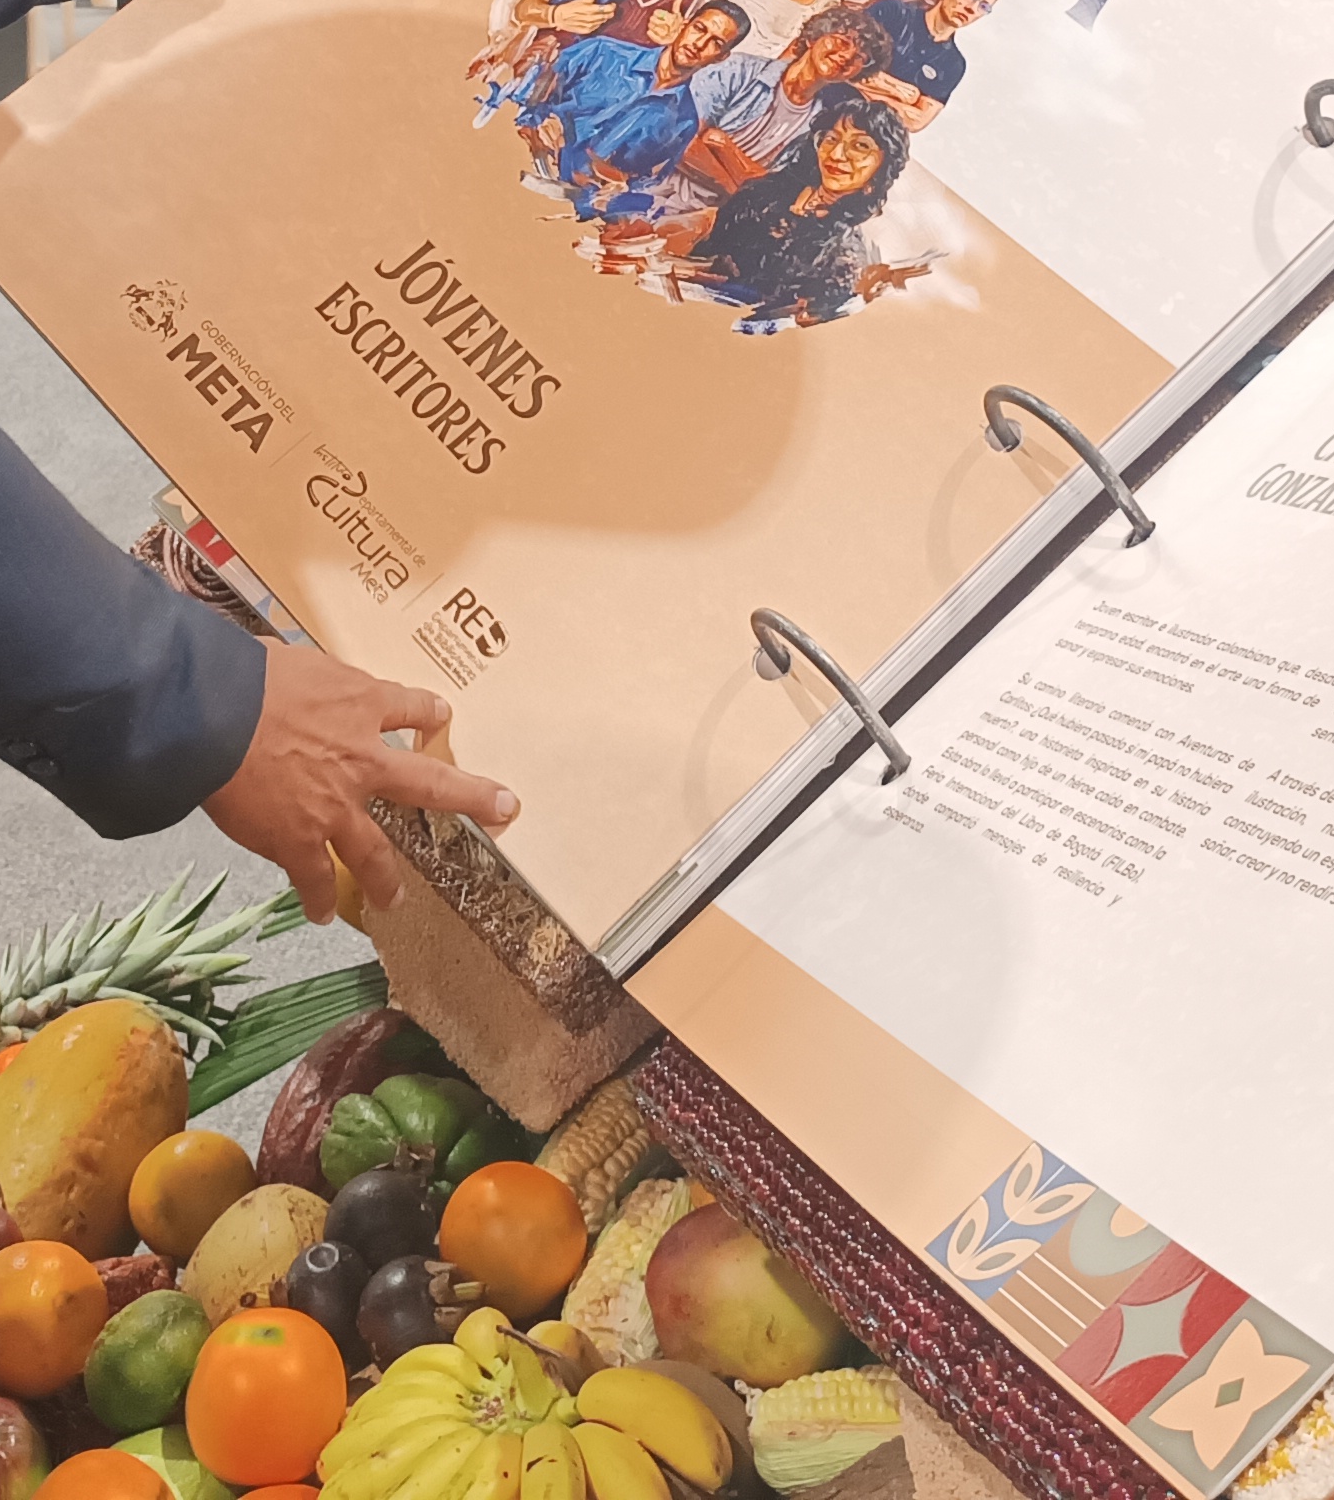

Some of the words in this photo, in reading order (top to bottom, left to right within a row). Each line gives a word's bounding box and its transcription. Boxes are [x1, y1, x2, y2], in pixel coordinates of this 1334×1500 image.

[374, 239, 562, 419] JÓVENES
[166, 332, 274, 454] META
[200, 320, 277, 400] GOBERNACIÓN
[272, 397, 295, 424] DEL
[314, 281, 506, 474] ESCRITORES
[349, 562, 388, 604] Meta
[1266, 769, 1281, 781] A
[1279, 774, 1320, 796] través
[1244, 790, 1306, 825] ilustración,
[1199, 837, 1236, 860] soñar,
[1235, 853, 1271, 872] crear
[1263, 866, 1279, 880] y
[1275, 871, 1295, 884] no
[1223, 815, 1302, 854] construyendo
[1301, 848, 1320, 861] un
